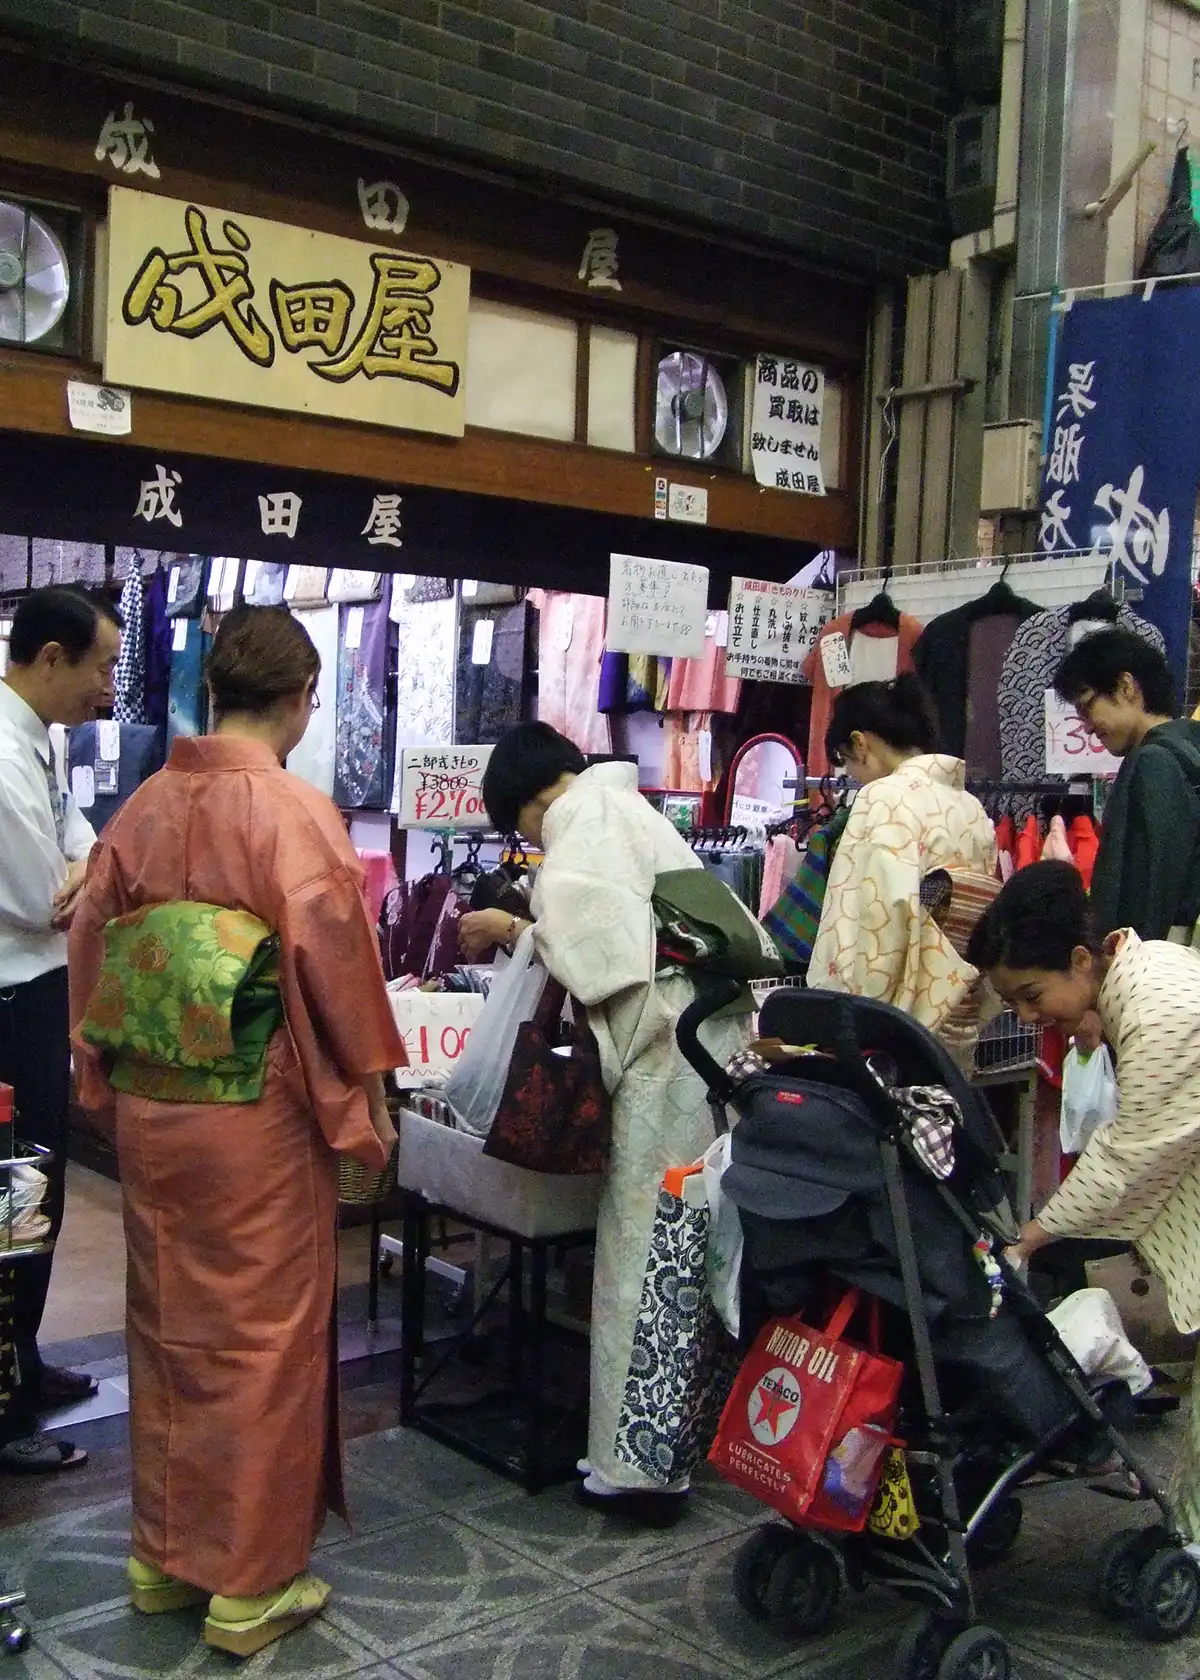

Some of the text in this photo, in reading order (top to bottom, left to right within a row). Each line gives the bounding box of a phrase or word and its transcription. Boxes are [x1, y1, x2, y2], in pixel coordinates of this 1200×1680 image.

[95, 102, 622, 291] 成田屋
[122, 205, 459, 397] 成田屋
[758, 359, 818, 393] 商品の
[769, 394, 820, 425] 買取は
[752, 432, 819, 461] 致しません
[776, 468, 820, 492] 成田屋
[134, 464, 403, 548] 成田屋
[732, 604, 744, 647] お仕立て
[766, 1326, 839, 1383] MOTOR OIL
[762, 1376, 799, 1402] TEXACO
[729, 1442, 791, 1482] LUBRICATES
